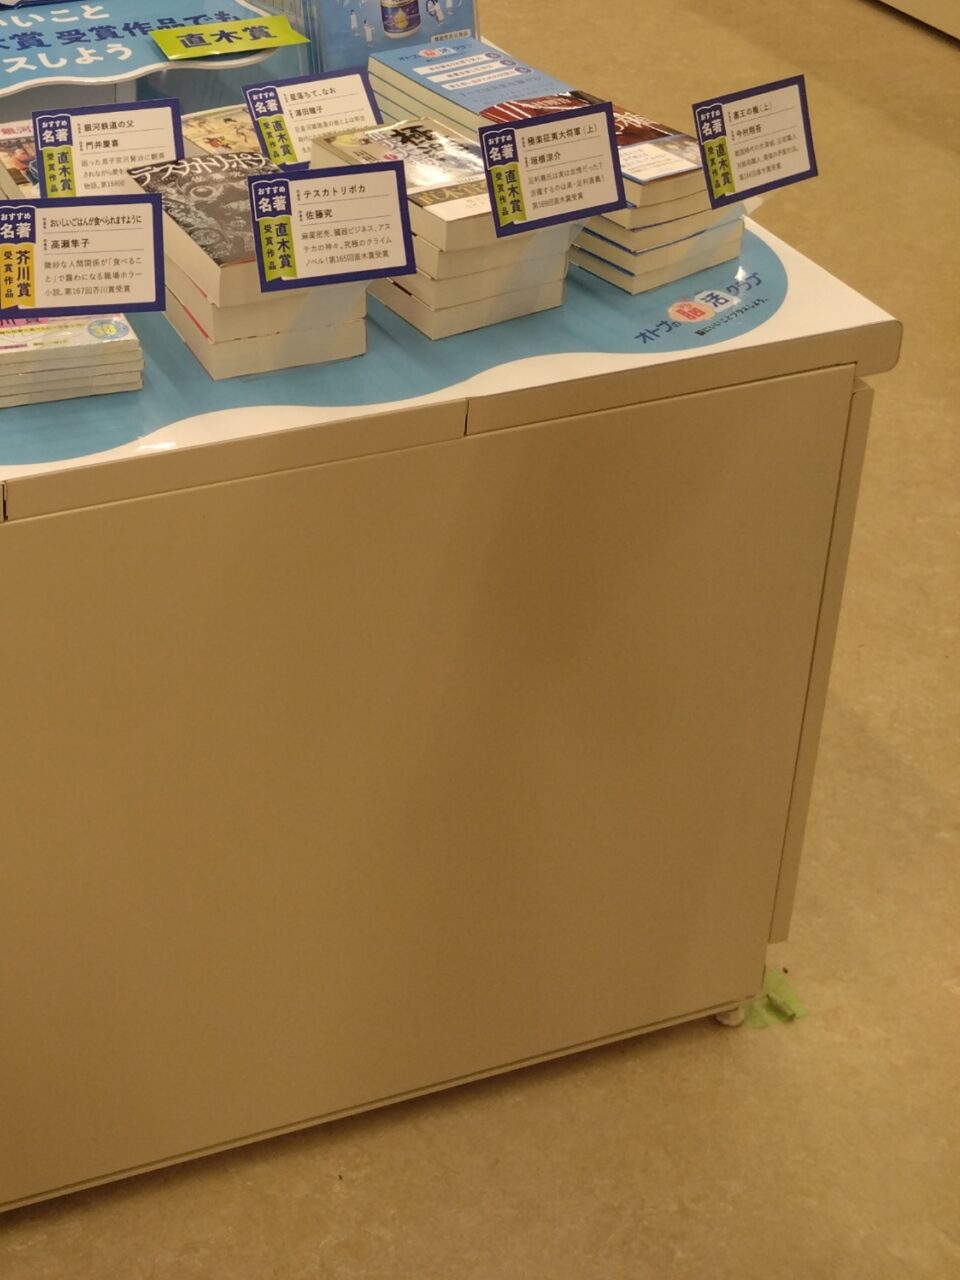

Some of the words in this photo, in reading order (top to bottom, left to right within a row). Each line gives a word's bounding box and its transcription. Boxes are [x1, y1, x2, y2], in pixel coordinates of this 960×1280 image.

[176, 23, 279, 49] 直木賞
[252, 91, 275, 101] おすすめ
[254, 98, 279, 115] 名著
[701, 110, 721, 121] おすすめ
[41, 120, 68, 129] おすすめ
[83, 119, 135, 133] 銀河鉄道の父
[701, 119, 723, 137] 名著
[42, 127, 69, 144] 名著
[85, 137, 120, 150] 門井慶喜
[263, 121, 281, 158] 受賞作品
[272, 120, 293, 157] 直木賞
[488, 134, 512, 145] おすすめ
[489, 144, 514, 162] 名著
[530, 151, 561, 165] 垣根涼介
[46, 152, 58, 193] 受賞作品
[57, 150, 73, 192] 直木賞
[707, 146, 721, 189] 受賞作品
[716, 143, 732, 187] 直木賞
[257, 185, 286, 196] おすすめ
[303, 184, 367, 199] テスカトリポカ
[495, 171, 509, 216] 受賞作品
[505, 169, 522, 214] 直木賞
[258, 195, 288, 213] 名著
[0, 211, 32, 221] おすすめ
[49, 214, 142, 228] おいしいごはんが食べられますように
[305, 209, 333, 221] 佐藤究
[0, 221, 32, 239] 名著
[50, 237, 91, 250] 高瀬隼子
[263, 224, 277, 270] 受賞作品
[275, 222, 293, 269] 直木賞
[3, 251, 15, 299] 受賞作品
[16, 249, 32, 298] 芥川賞
